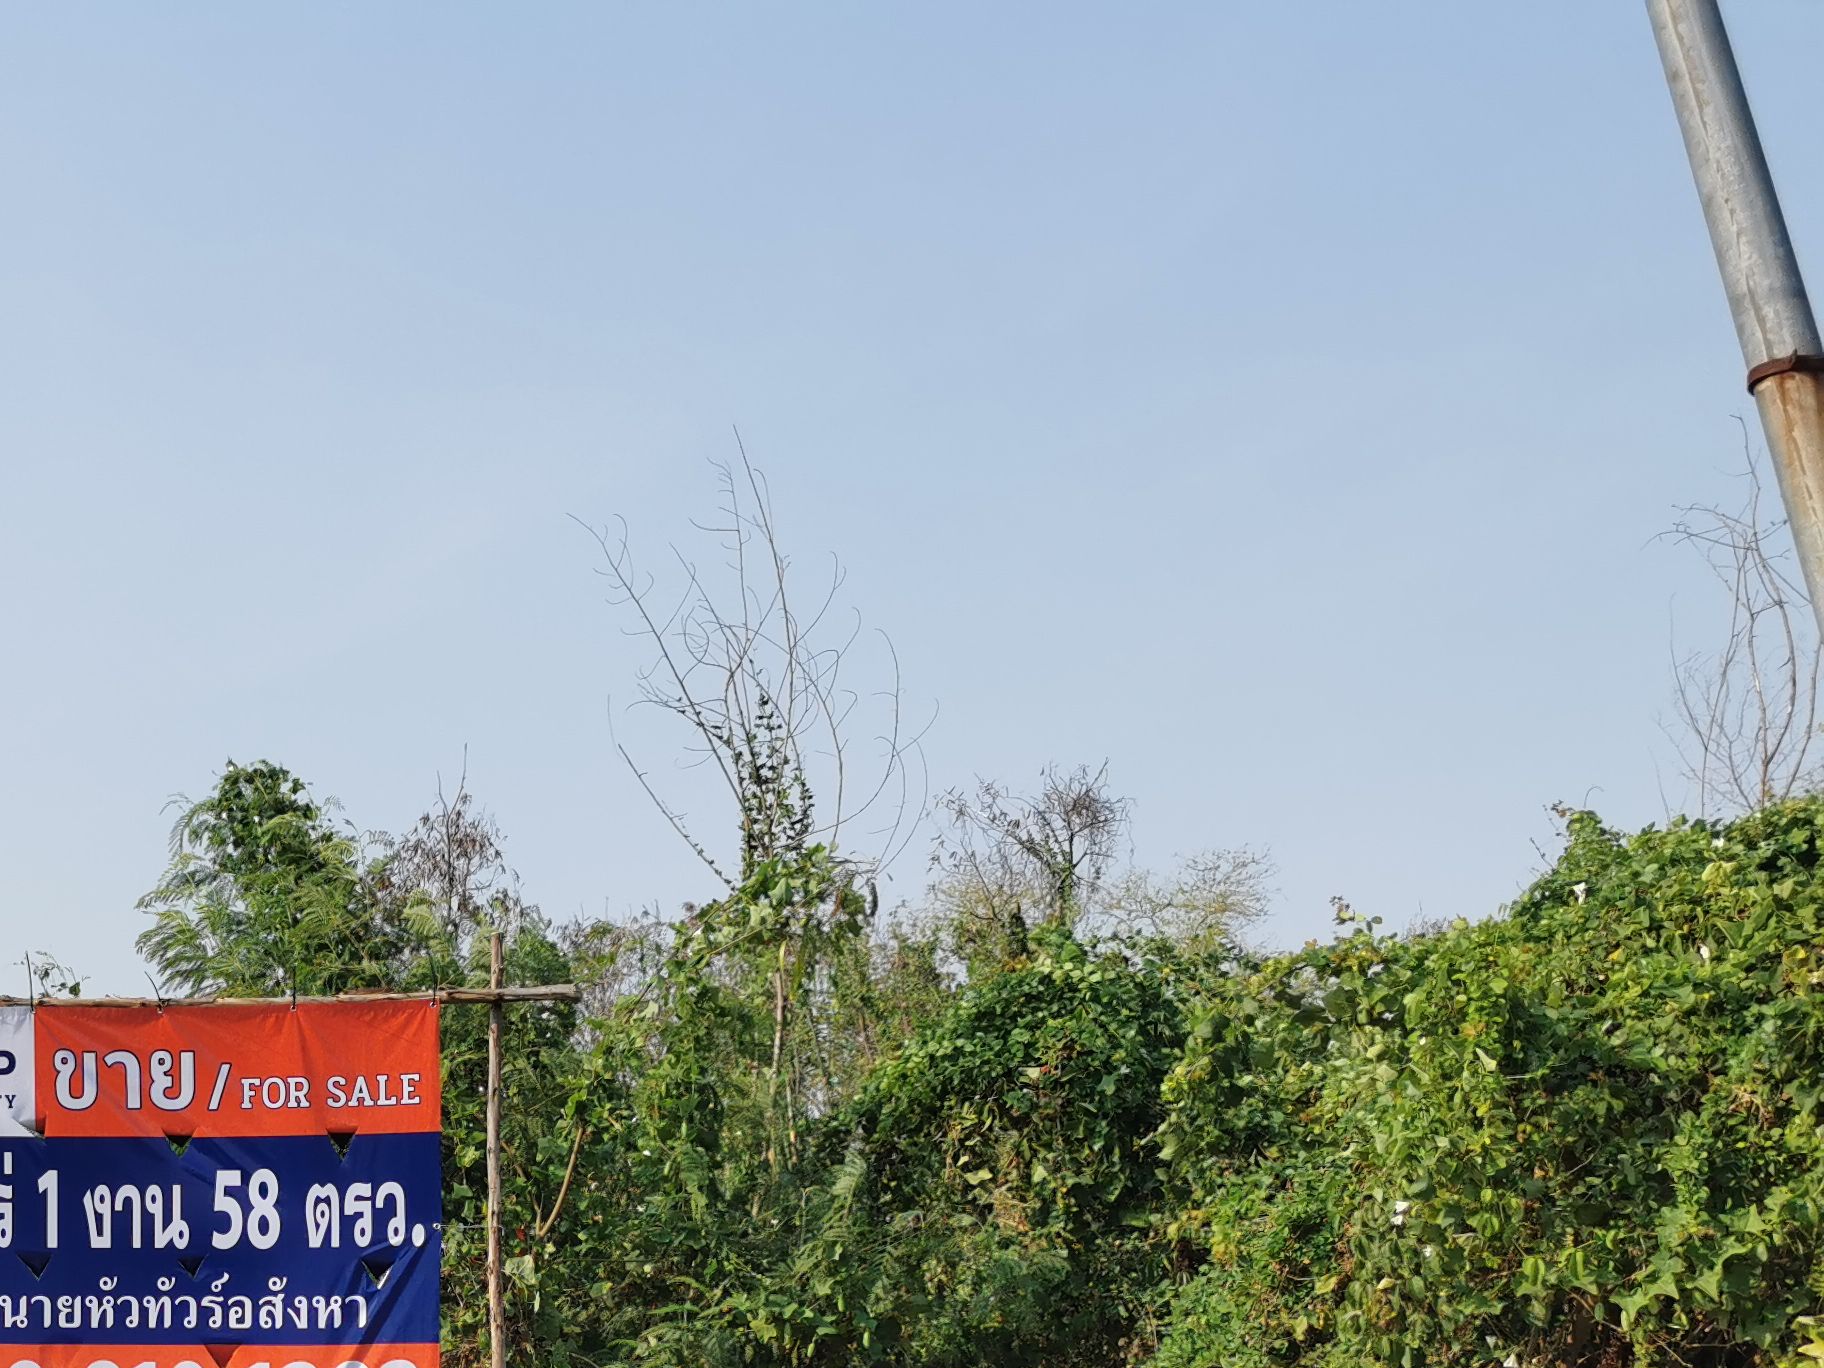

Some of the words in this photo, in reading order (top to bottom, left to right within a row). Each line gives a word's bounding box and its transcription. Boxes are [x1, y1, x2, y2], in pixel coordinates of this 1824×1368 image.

[52, 1048, 195, 1112] ขาย
[239, 1075, 311, 1110] FOR
[326, 1073, 422, 1109] SALE
[36, 1169, 59, 1249] 1
[82, 1183, 191, 1250] งาน
[211, 1168, 281, 1250] 58
[304, 1180, 425, 1248] ตรว.
